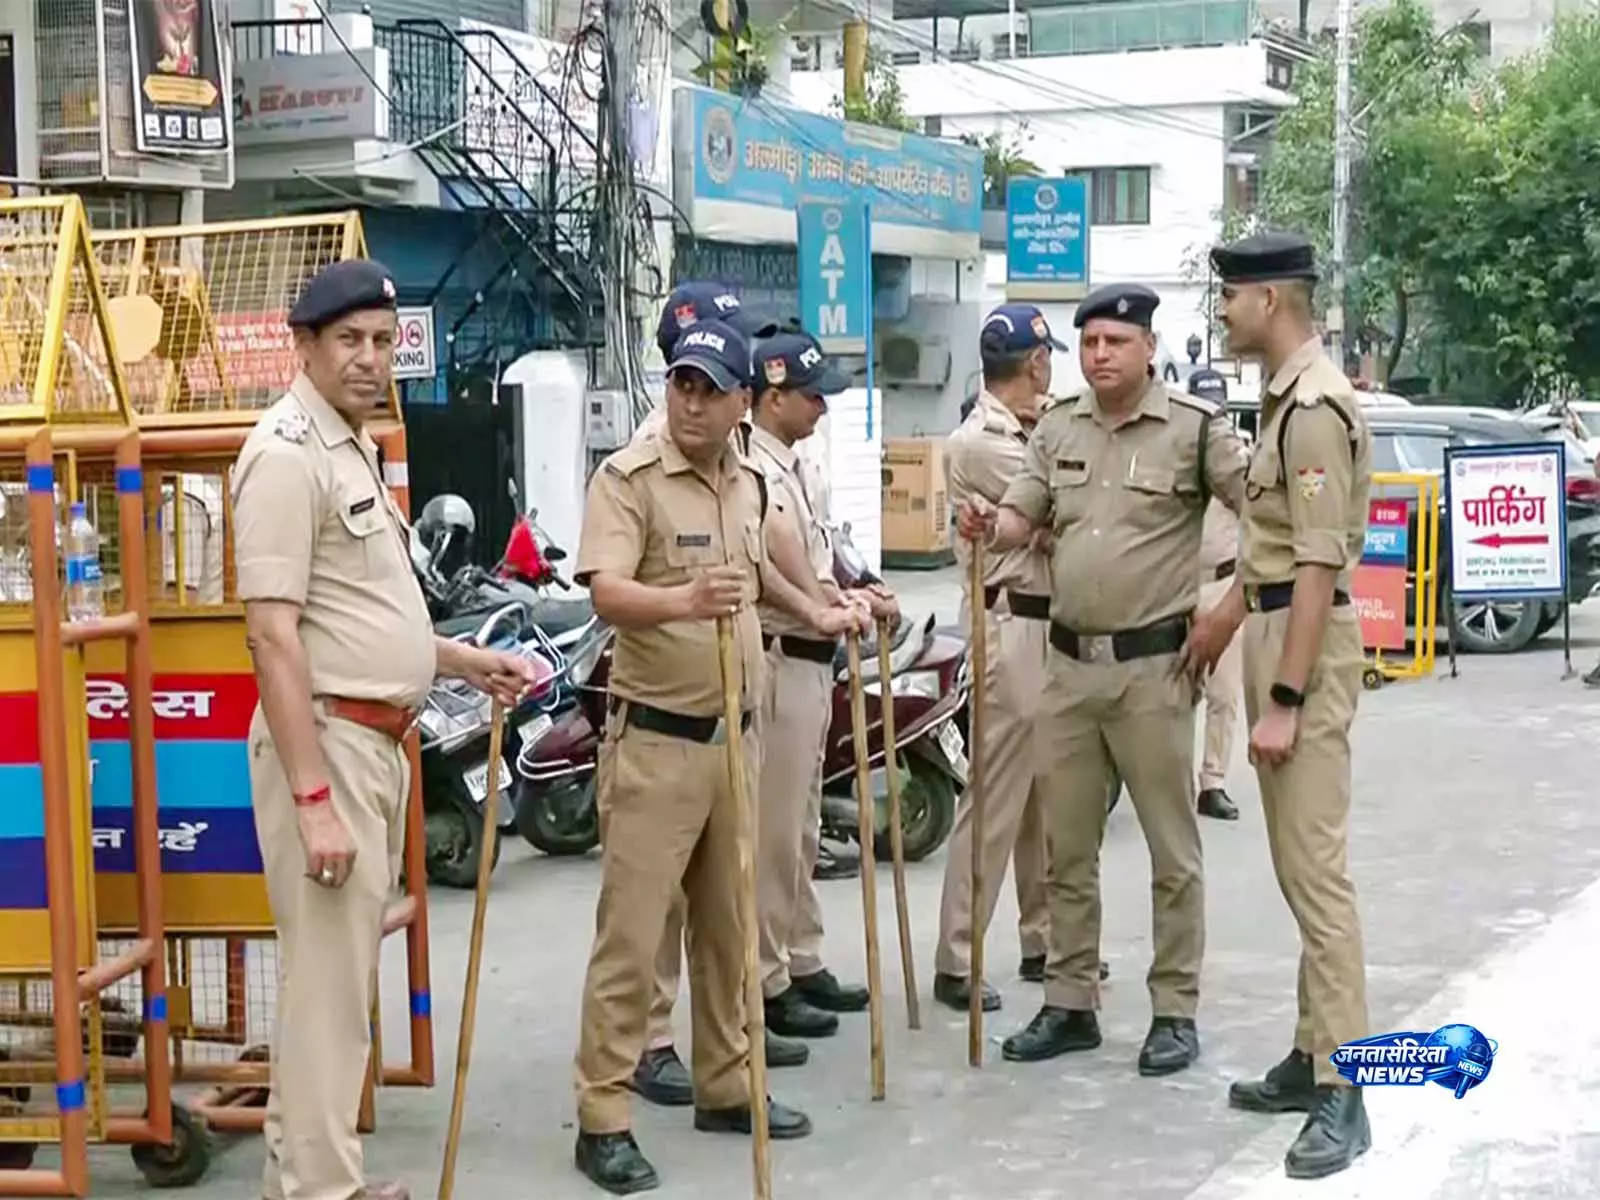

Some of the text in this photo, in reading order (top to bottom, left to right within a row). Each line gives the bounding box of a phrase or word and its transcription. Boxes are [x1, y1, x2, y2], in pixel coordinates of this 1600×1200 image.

[819, 233, 847, 336] ATM
[683, 331, 726, 353] POLICE
[394, 350, 425, 367] KING
[1462, 485, 1546, 527] पार्किंग
